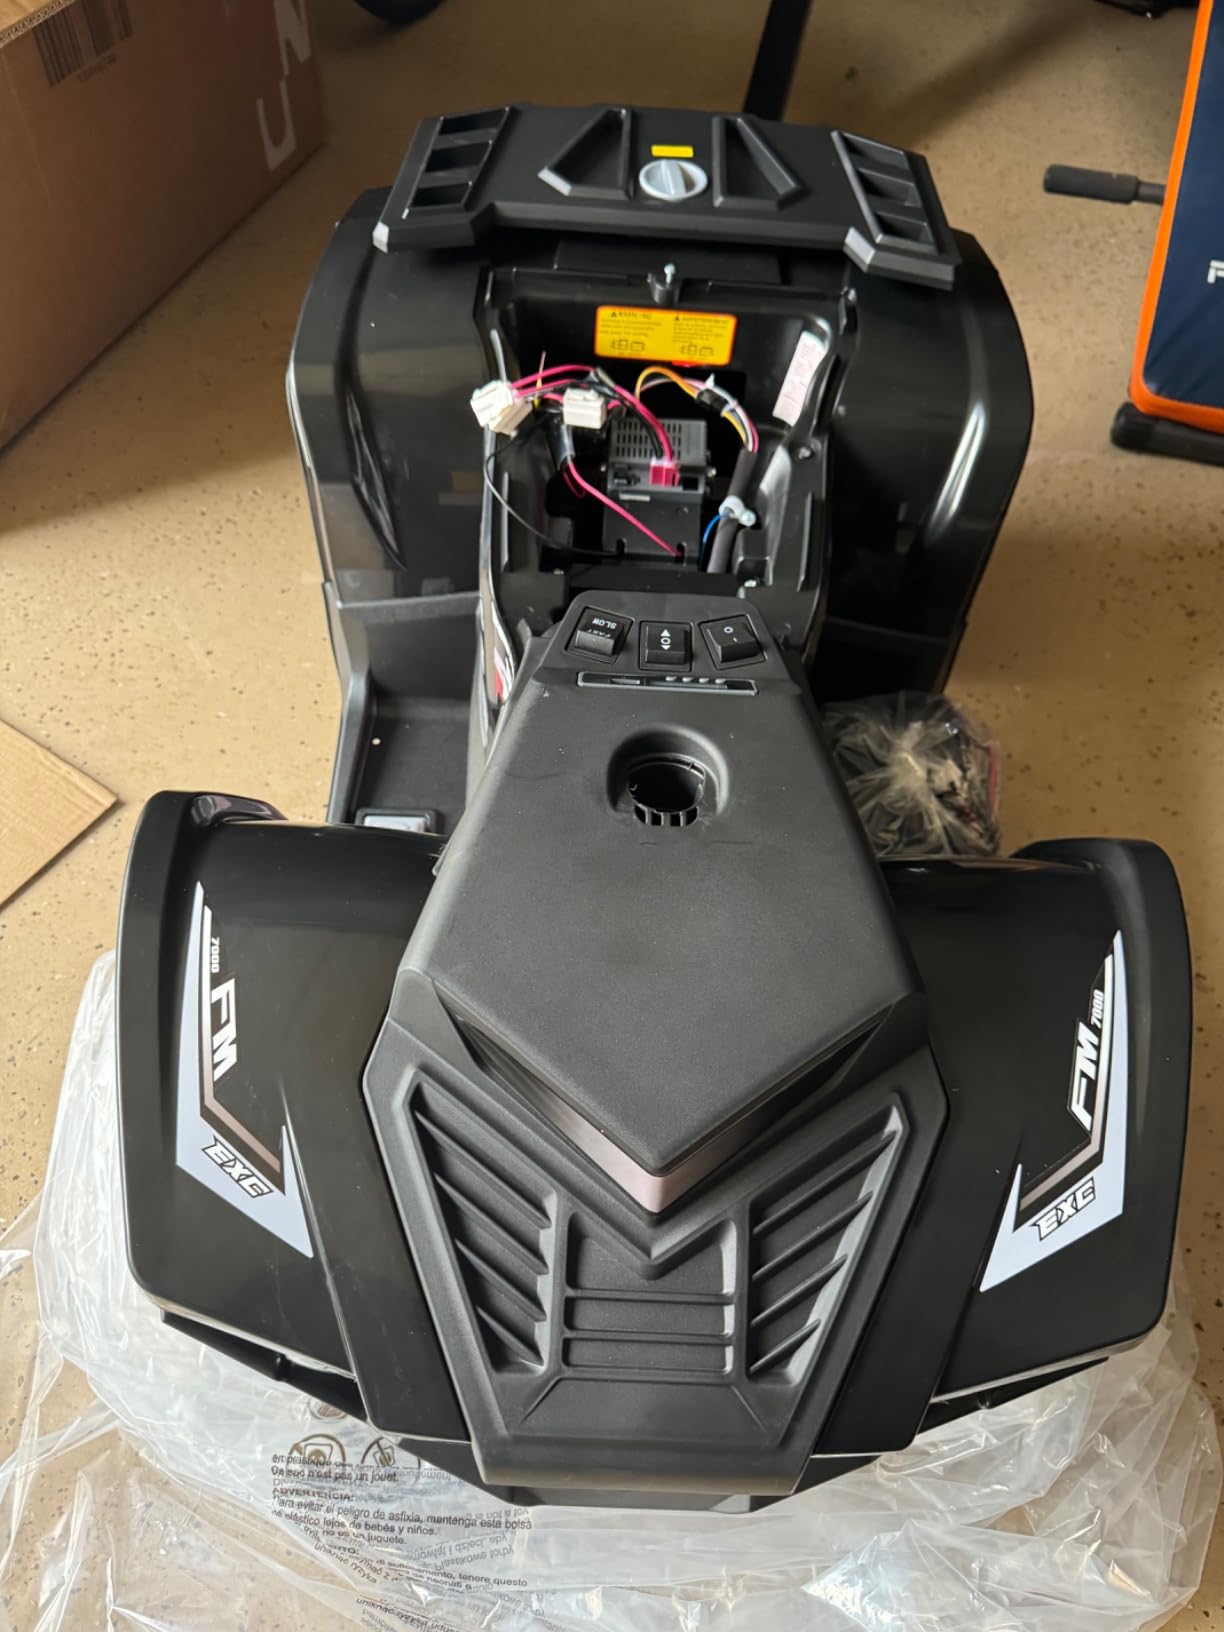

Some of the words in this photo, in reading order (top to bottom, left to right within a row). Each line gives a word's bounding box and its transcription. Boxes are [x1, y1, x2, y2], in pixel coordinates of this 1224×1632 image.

[592, 617, 617, 630] SLOW
[211, 936, 220, 974] 7000
[211, 977, 238, 1083] FM
[1071, 1021, 1099, 1132] FM
[1091, 989, 1104, 1029] 7000
[297, 1500, 323, 1512] evitar
[337, 1506, 370, 1519] peligro
[373, 1509, 386, 1519] de
[388, 1511, 425, 1523] asfixia,
[427, 1514, 478, 1528] mantenga
[480, 1519, 502, 1528] esta
[504, 1518, 532, 1529] bolsa
[323, 1517, 346, 1529] lejos
[349, 1520, 362, 1530] de
[364, 1521, 396, 1533] bebés
[398, 1525, 405, 1536] y
[407, 1524, 438, 1537] niños.
[367, 1533, 408, 1545] juguete.
[493, 1577, 528, 1588] questo
